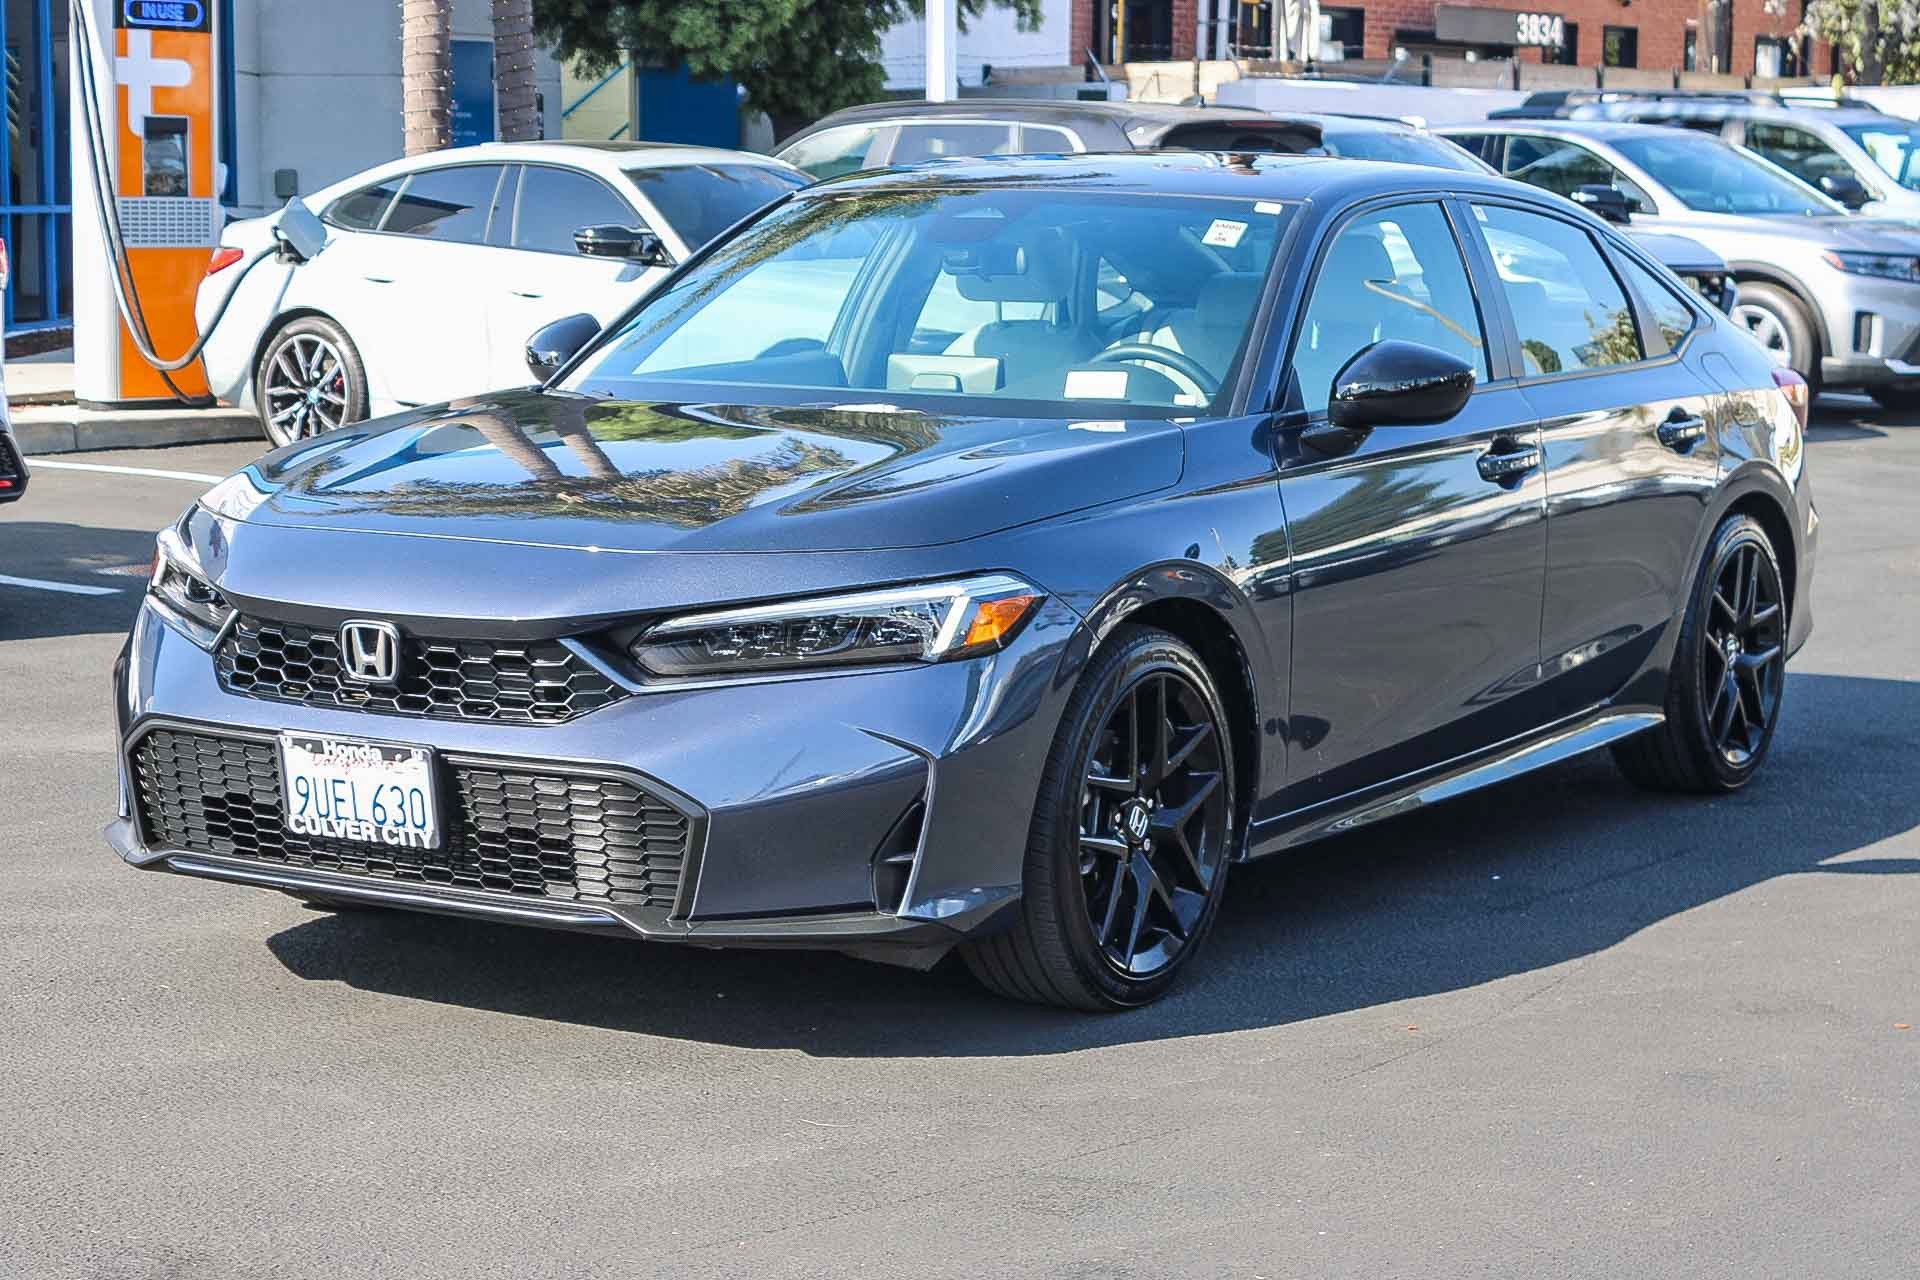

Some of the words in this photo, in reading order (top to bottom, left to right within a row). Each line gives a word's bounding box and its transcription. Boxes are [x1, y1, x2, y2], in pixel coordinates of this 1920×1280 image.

[141, 3, 156, 18] IN
[157, 4, 184, 20] USE
[1516, 13, 1564, 47] 3834
[295, 775, 426, 830] 9UEL630
[288, 814, 378, 842] CULVER
[381, 826, 434, 849] CITY
